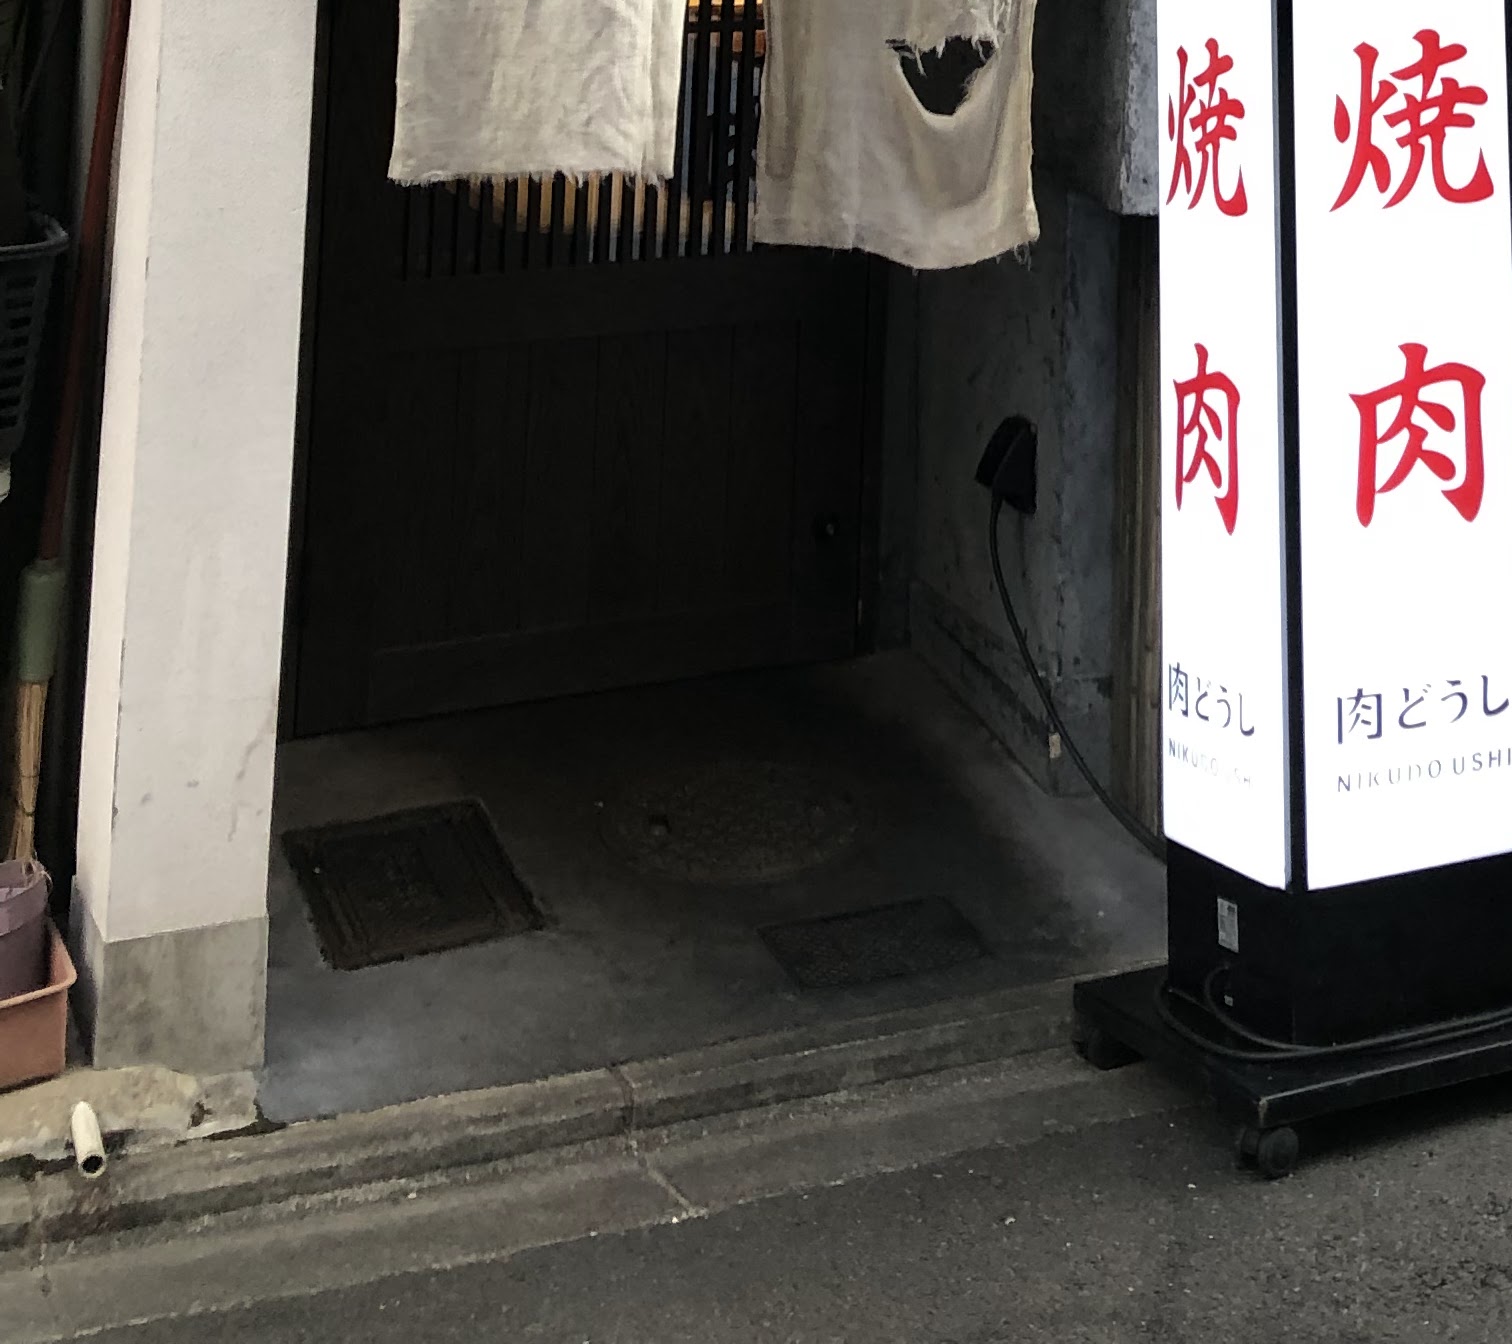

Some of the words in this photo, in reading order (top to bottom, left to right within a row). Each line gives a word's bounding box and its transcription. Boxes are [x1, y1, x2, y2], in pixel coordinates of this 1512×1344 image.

[1164, 36, 1249, 538] 焼肉
[1329, 27, 1496, 530] 焼肉
[1168, 661, 1256, 737] 肉どうし
[1337, 675, 1511, 744] 肉どうし
